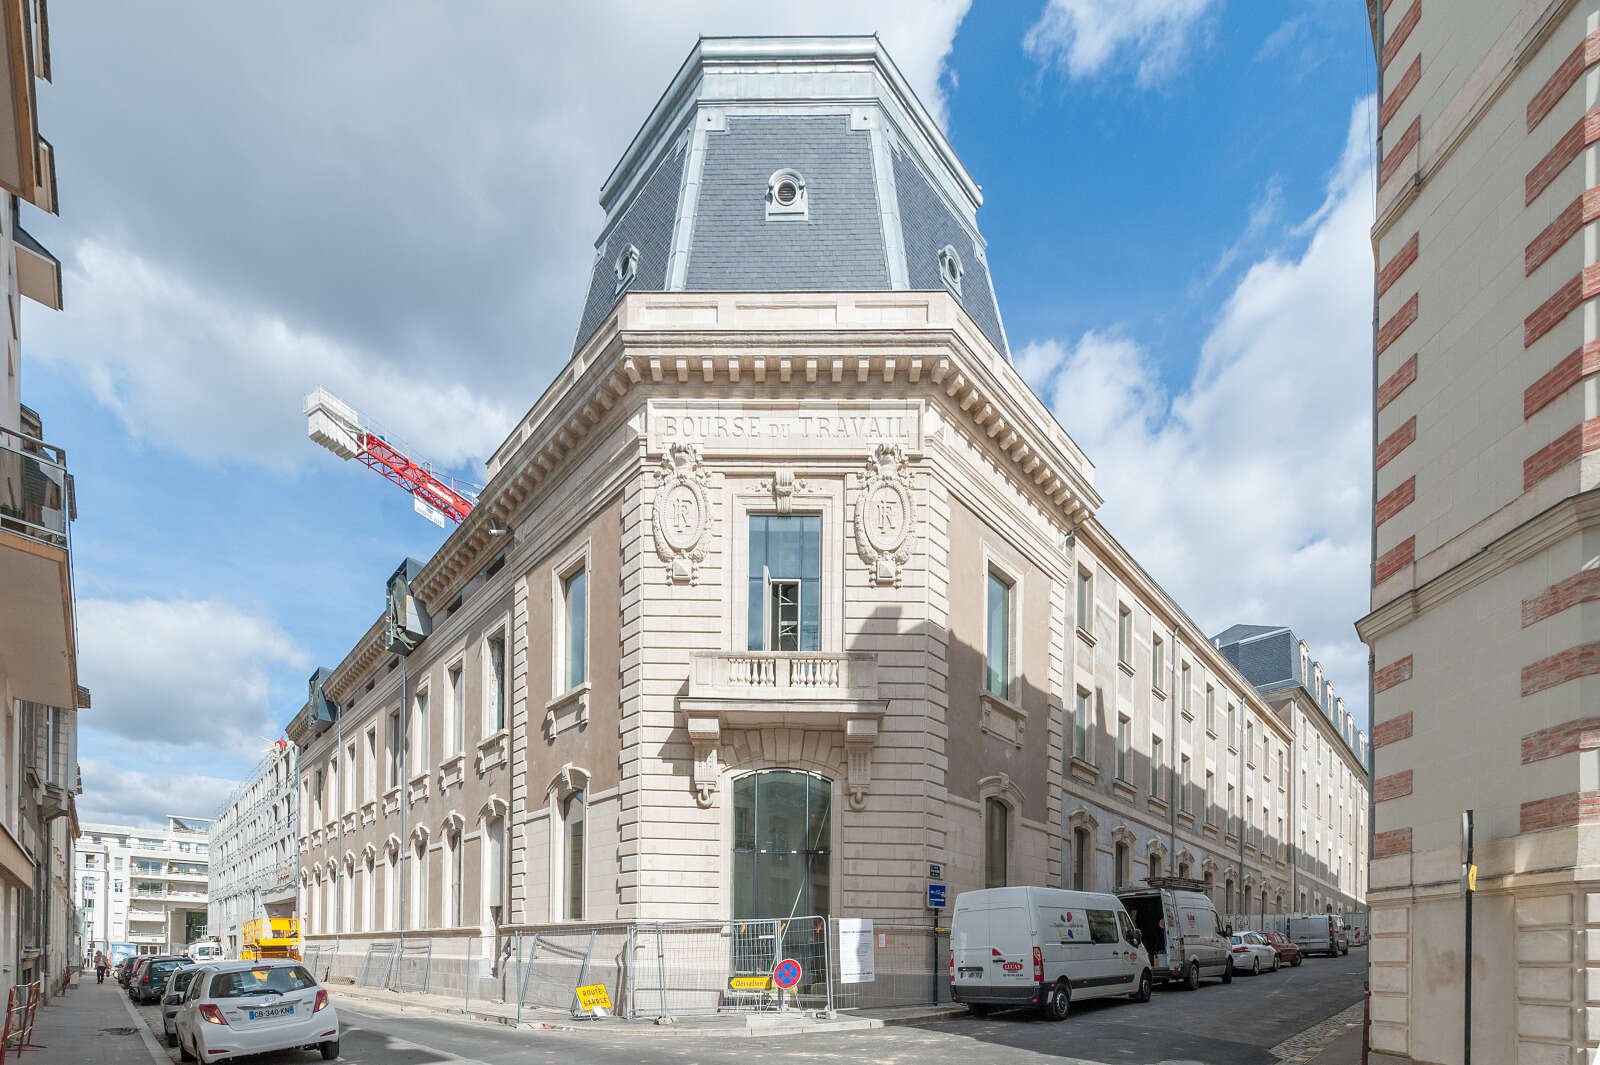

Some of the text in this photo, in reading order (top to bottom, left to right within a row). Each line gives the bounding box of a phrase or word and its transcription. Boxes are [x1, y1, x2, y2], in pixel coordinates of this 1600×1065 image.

[663, 416, 910, 438] BOURSE DU TRAVAIL
